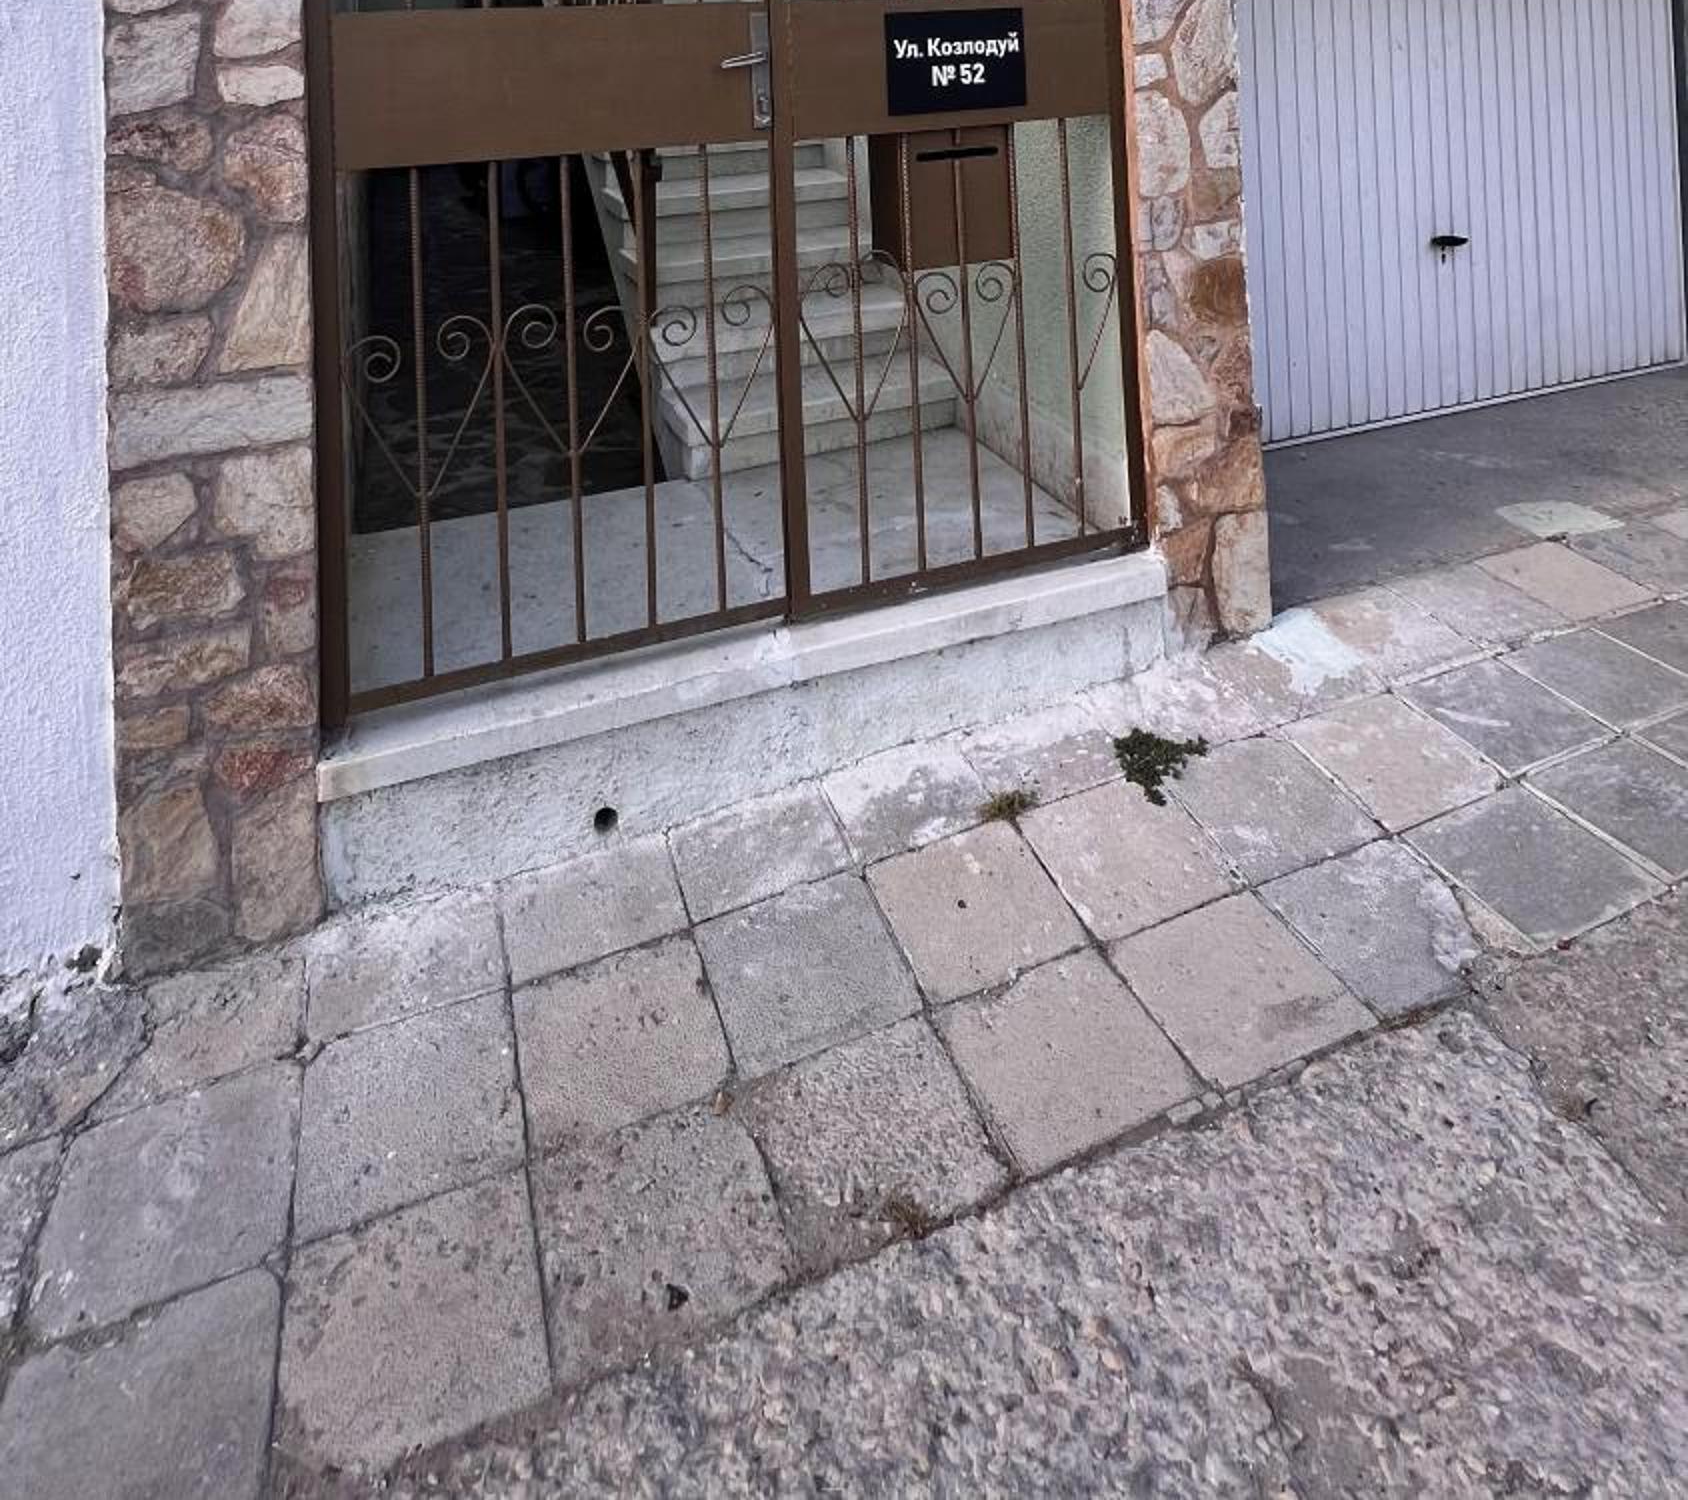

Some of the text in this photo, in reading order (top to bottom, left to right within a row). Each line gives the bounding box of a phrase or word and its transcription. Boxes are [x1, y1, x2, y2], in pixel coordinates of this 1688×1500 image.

[894, 31, 1019, 59] Ул. Козлодуй
[959, 62, 986, 85] 52
